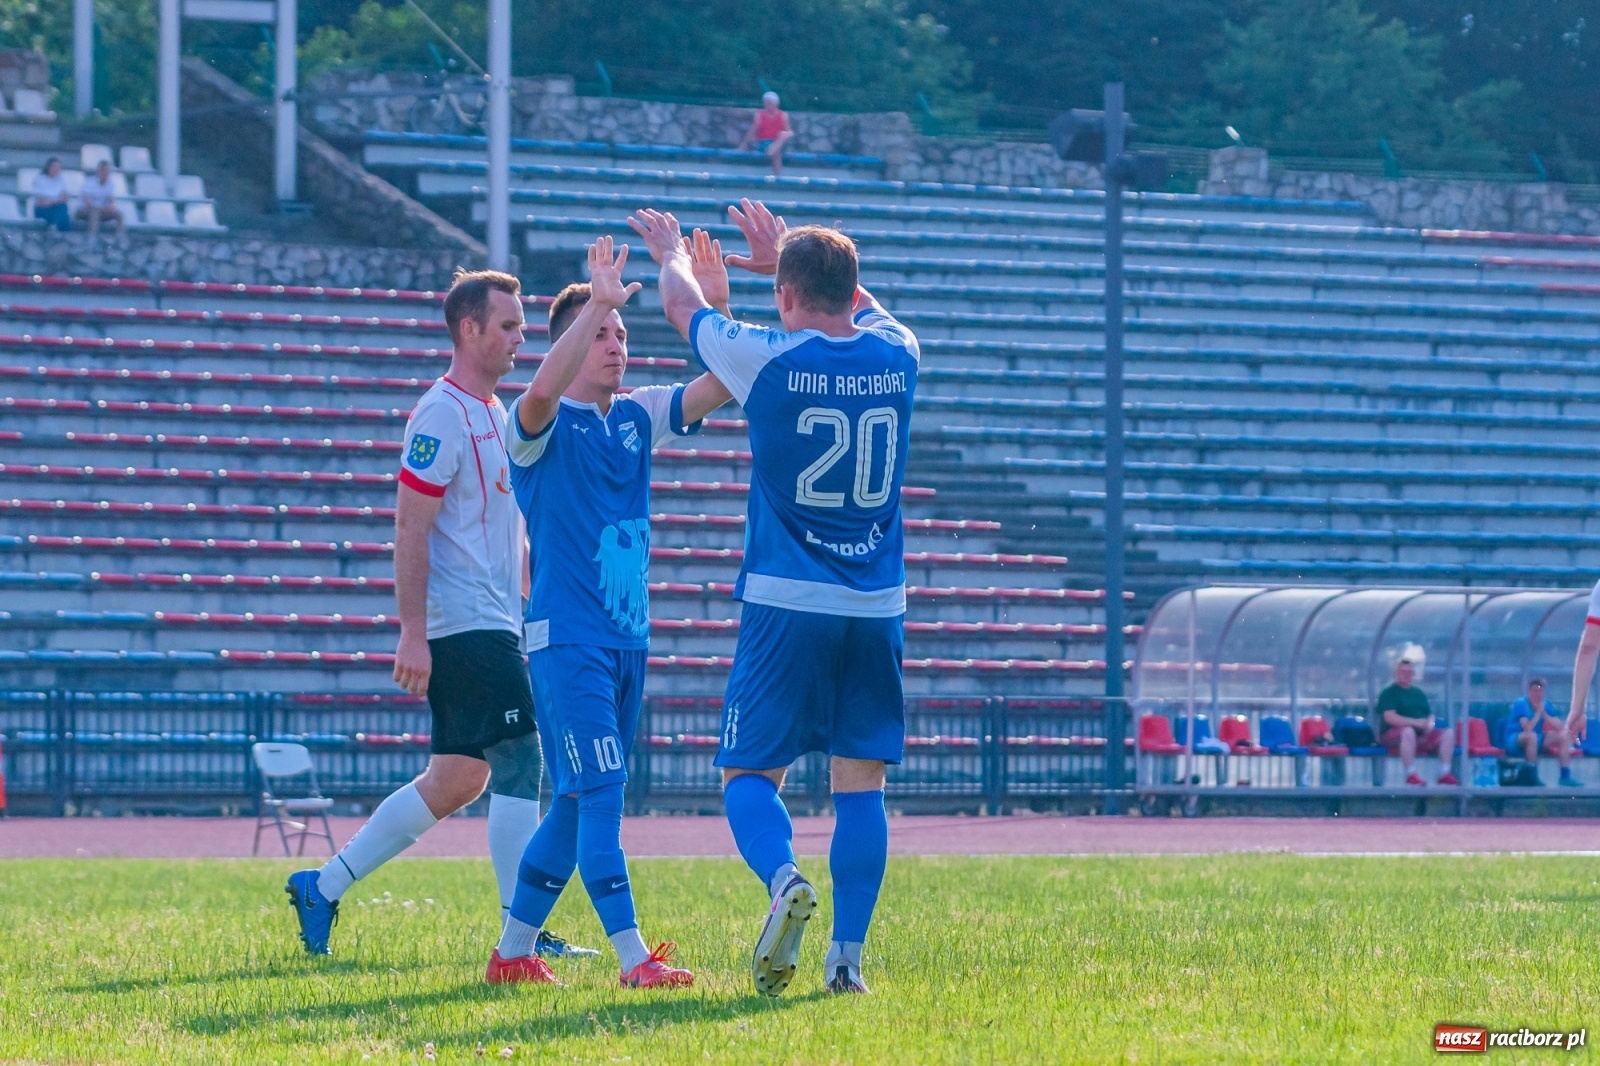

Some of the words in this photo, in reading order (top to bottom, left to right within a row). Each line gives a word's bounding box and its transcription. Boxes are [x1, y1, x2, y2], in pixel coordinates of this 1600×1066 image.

[788, 370, 828, 395] UNIA
[835, 368, 907, 396] RACIBÓRZ
[795, 406, 898, 508] 20
[593, 735, 622, 773] 10
